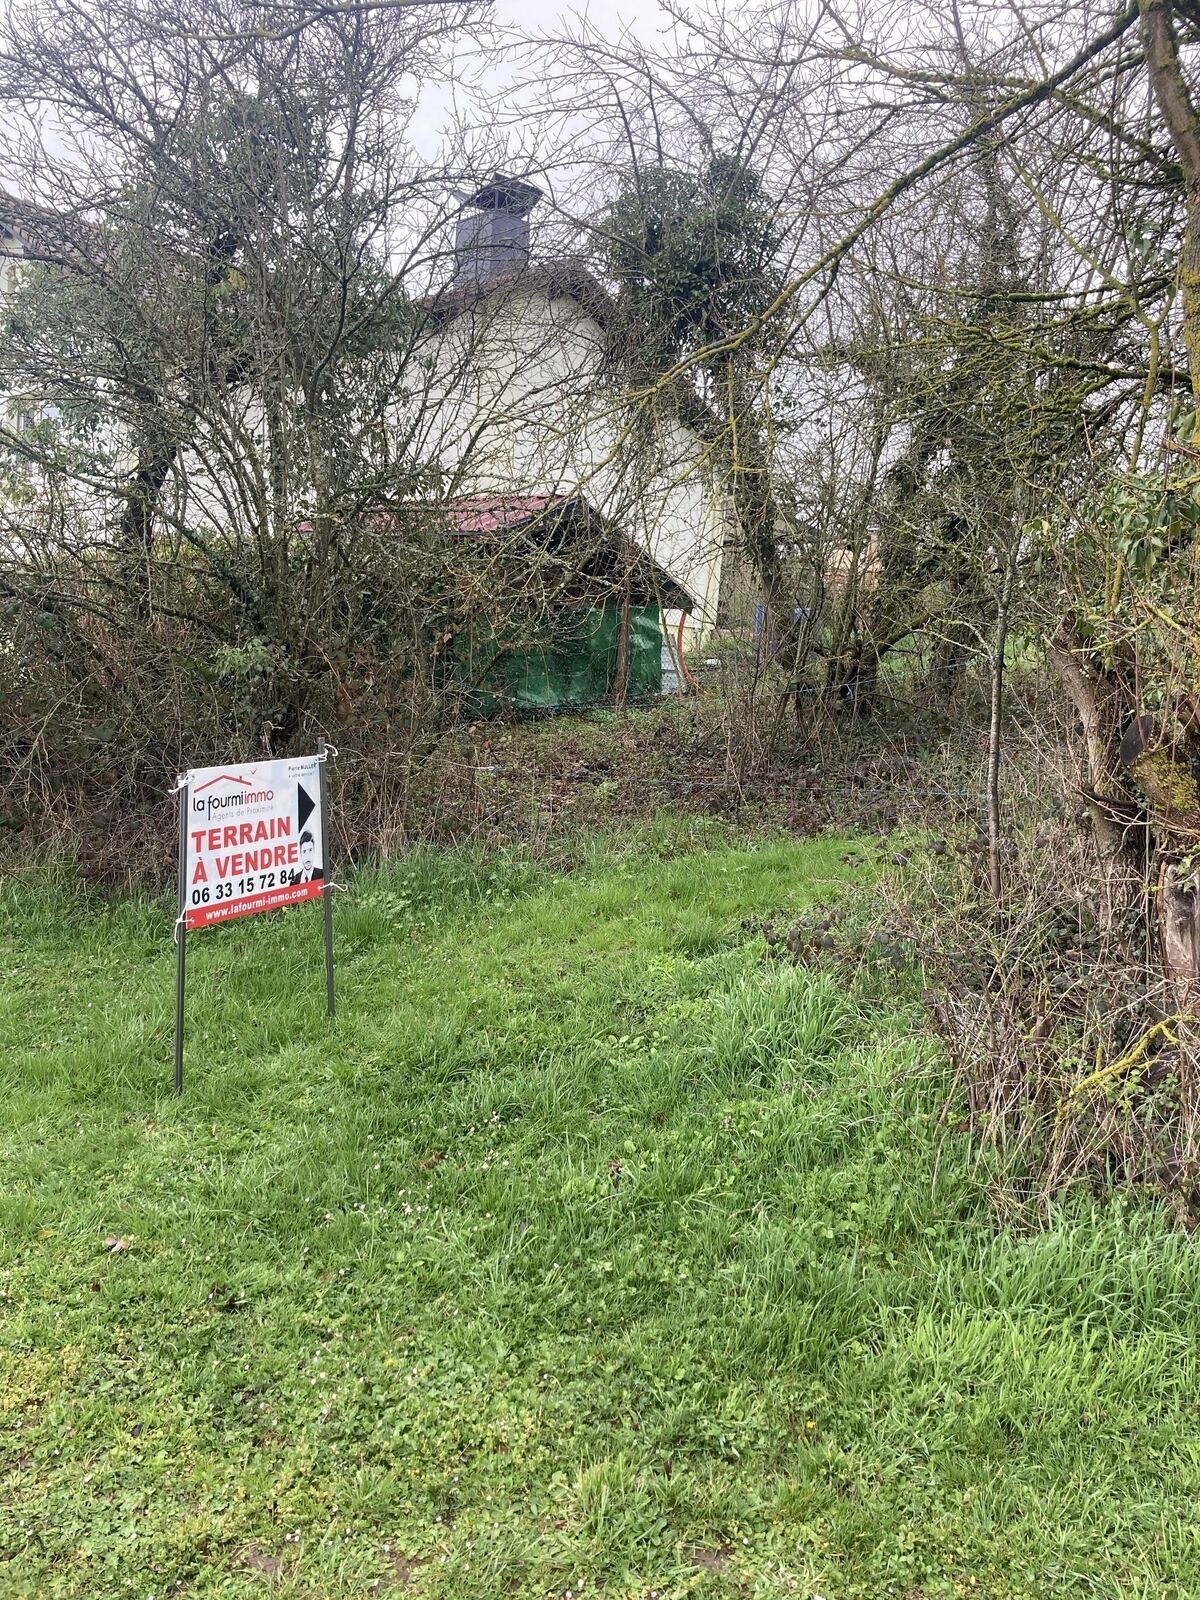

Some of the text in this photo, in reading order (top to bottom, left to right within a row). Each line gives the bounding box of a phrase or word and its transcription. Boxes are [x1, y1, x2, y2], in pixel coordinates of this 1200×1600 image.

[193, 797, 205, 812] la
[212, 810, 234, 822] Agents
[247, 804, 274, 816] Proximité
[191, 816, 291, 853] TERRAIN
[192, 842, 299, 885] À VENDRE
[192, 867, 297, 905] 06 33 15 72 84
[205, 887, 308, 920] www.lafourmi-immo.com
